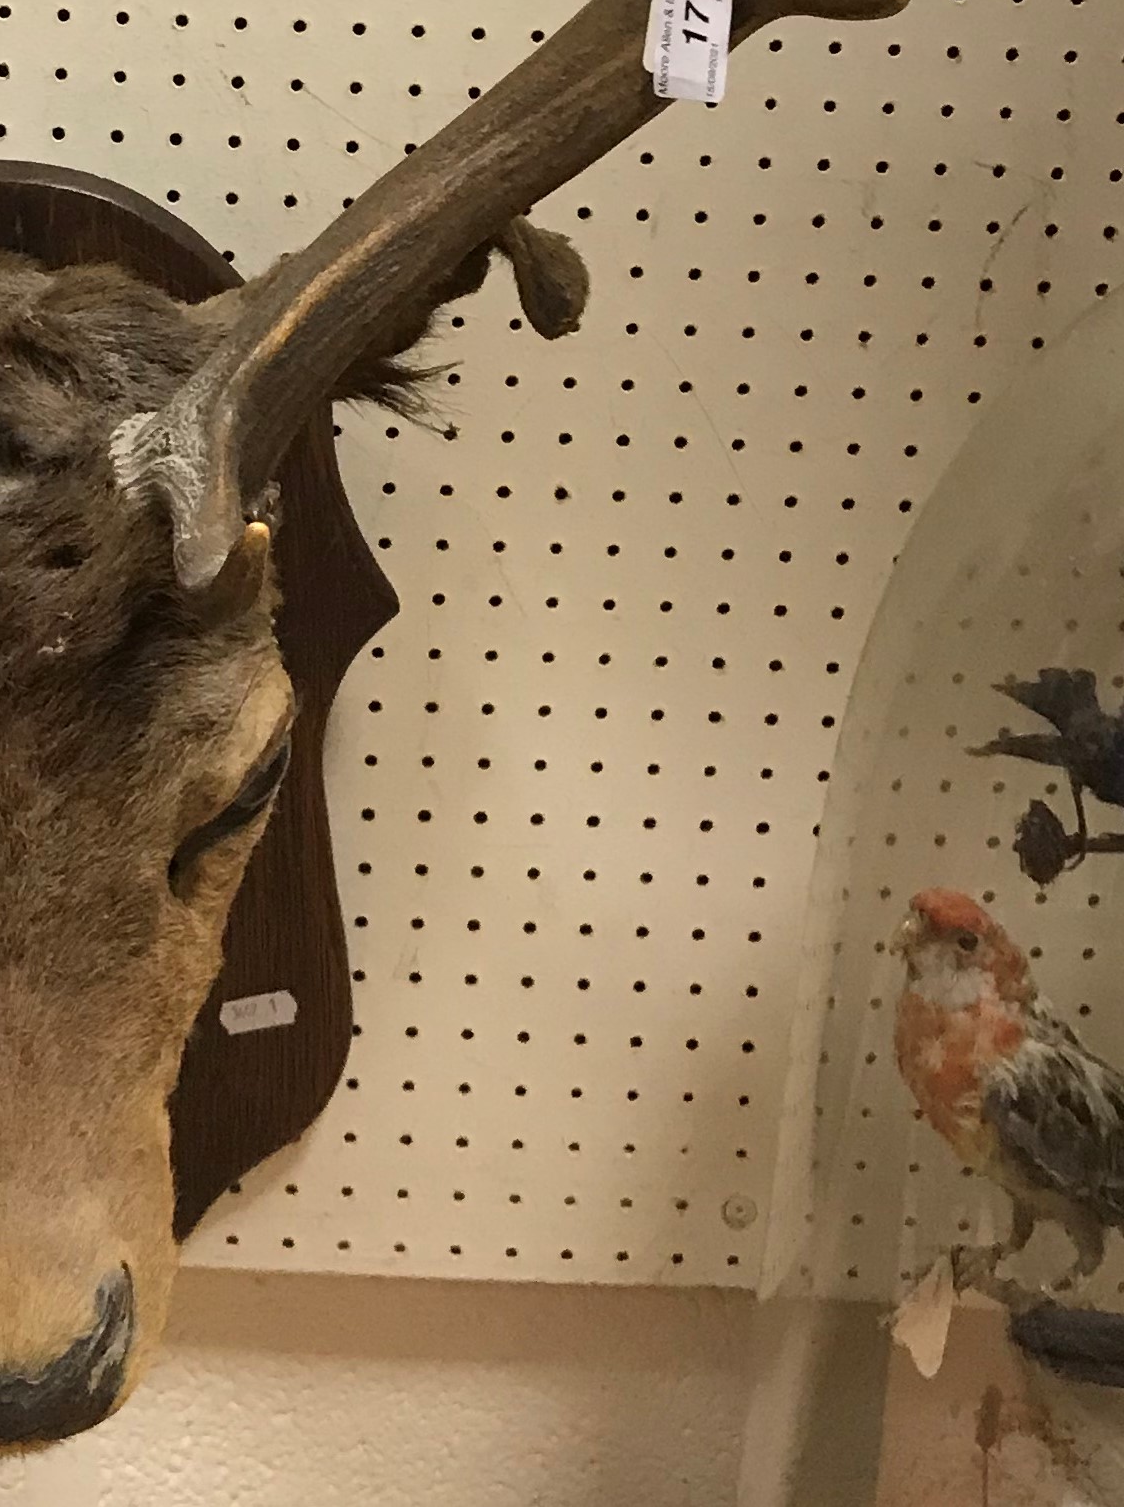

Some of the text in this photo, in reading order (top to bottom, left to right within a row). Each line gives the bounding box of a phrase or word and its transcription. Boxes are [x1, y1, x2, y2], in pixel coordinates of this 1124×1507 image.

[663, 8, 675, 18] &
[682, 0, 709, 44] 17
[661, 20, 674, 52] Allen
[658, 55, 671, 95] Moore
